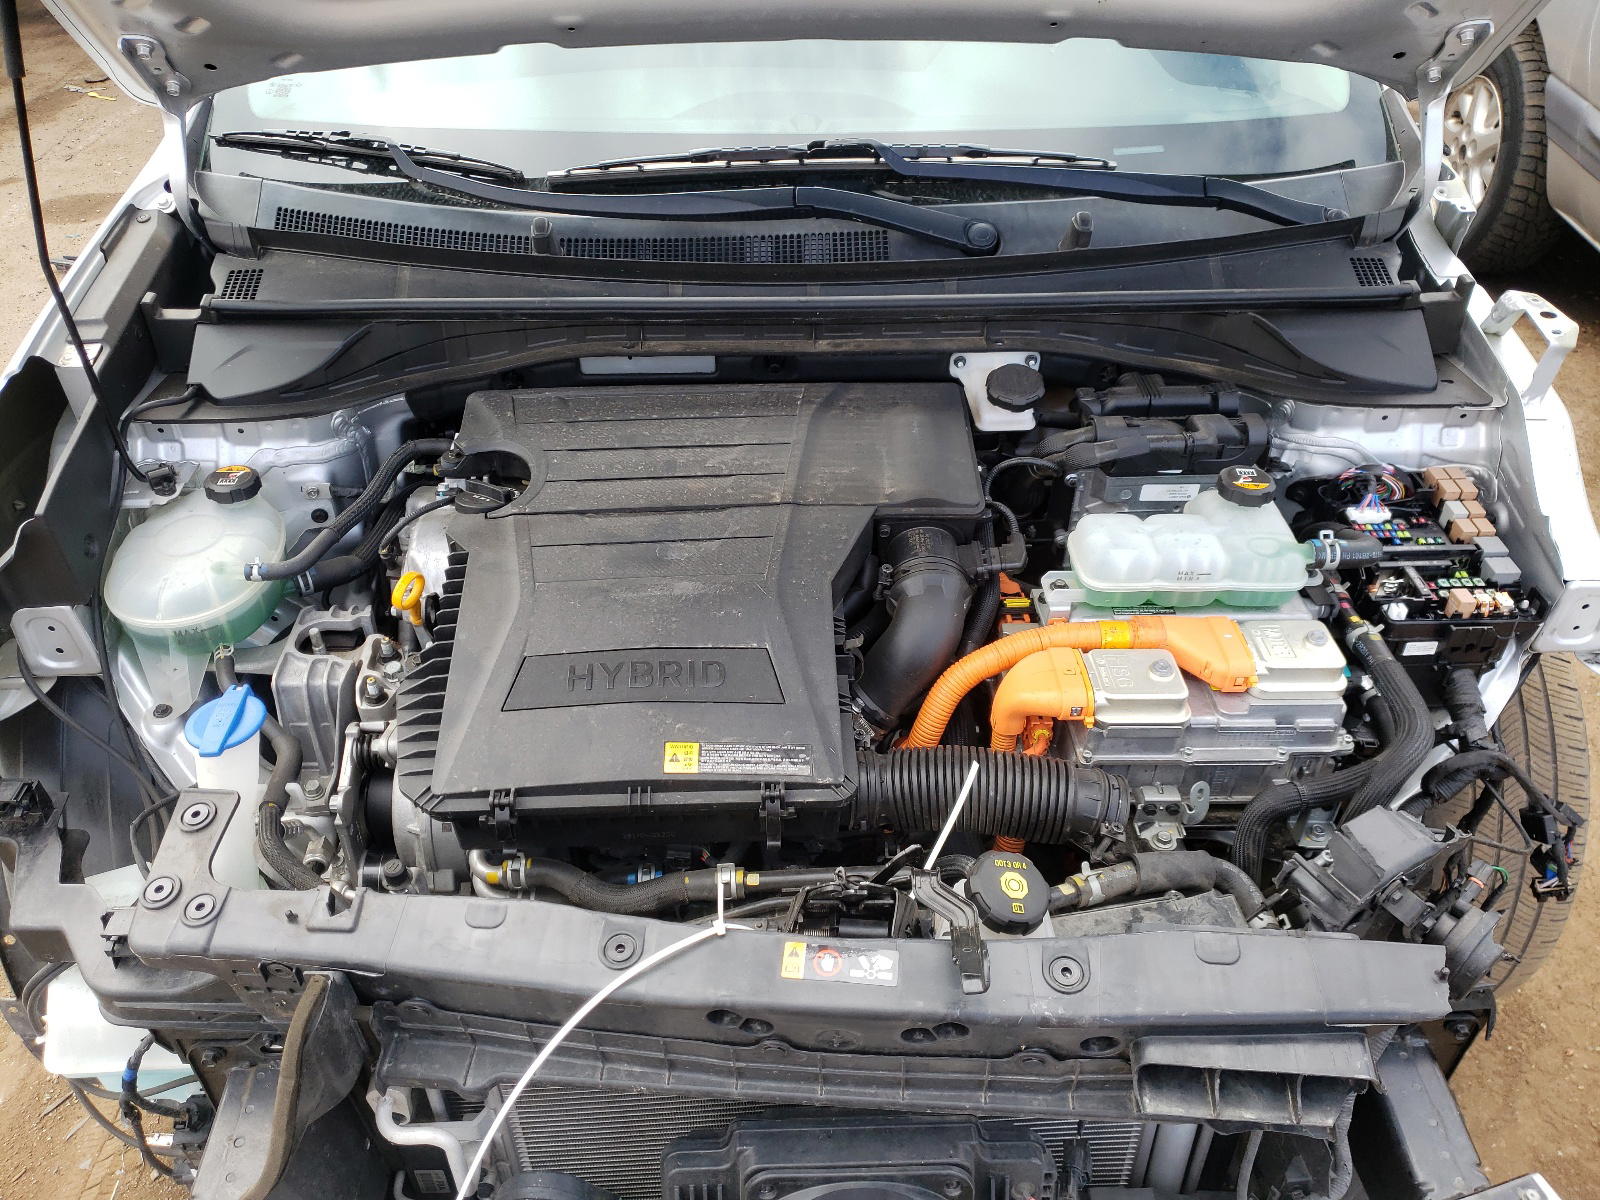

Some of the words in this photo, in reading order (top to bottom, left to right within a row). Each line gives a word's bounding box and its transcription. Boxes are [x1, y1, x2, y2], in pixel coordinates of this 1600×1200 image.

[567, 660, 727, 692] HYBRID
[994, 859, 1011, 868] DOT3
[1012, 861, 1021, 869] OR
[1022, 862, 1027, 870] 4
